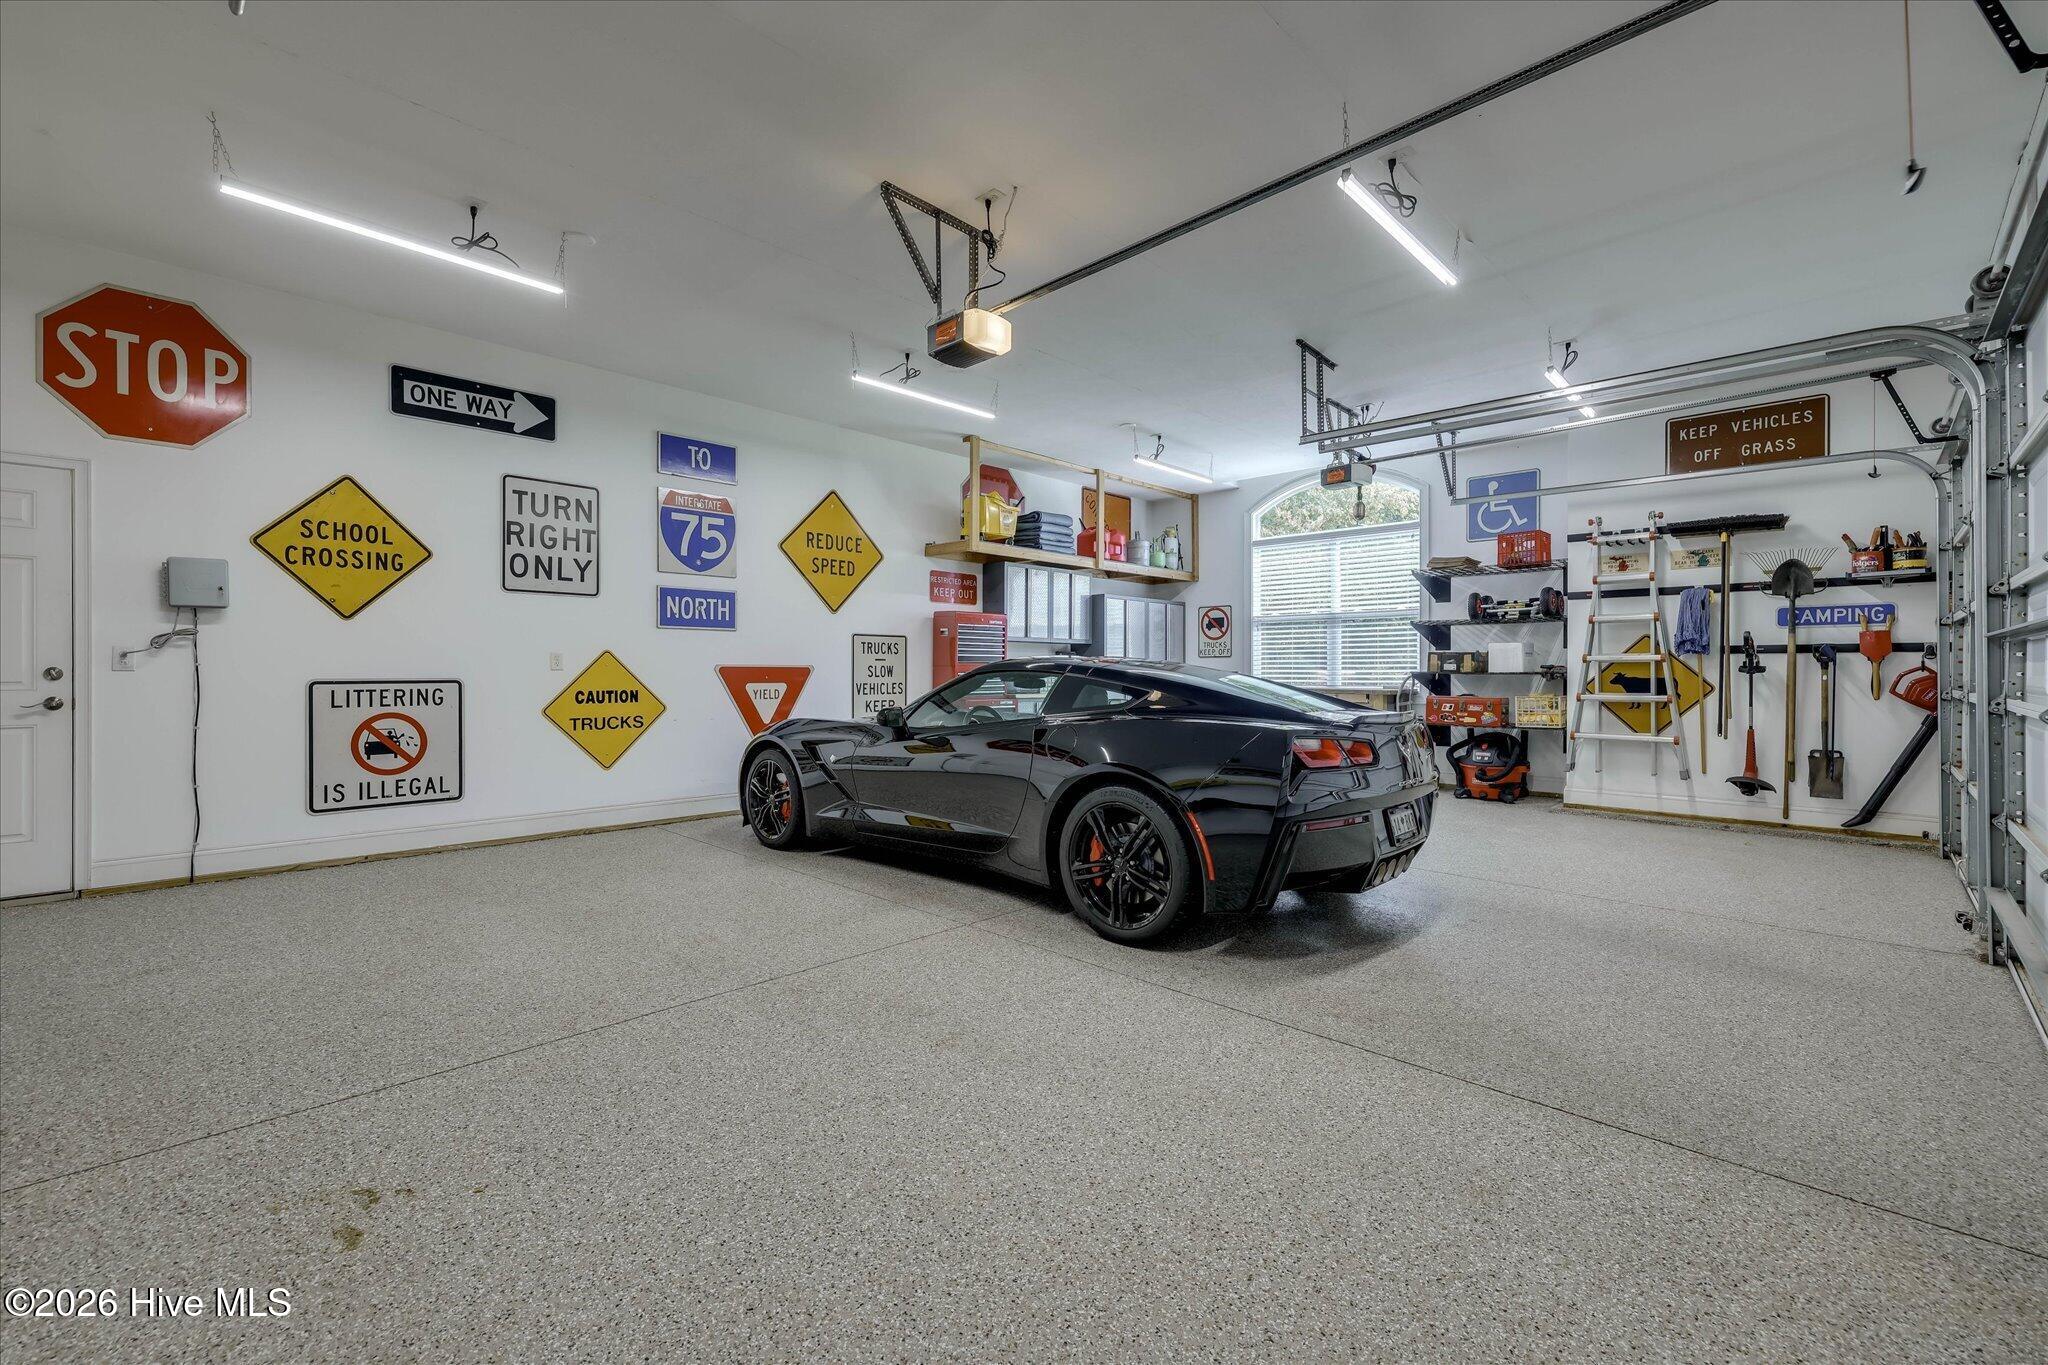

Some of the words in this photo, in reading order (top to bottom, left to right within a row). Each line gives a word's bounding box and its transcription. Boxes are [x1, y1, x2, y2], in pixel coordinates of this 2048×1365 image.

[55, 322, 239, 409] STOP
[410, 384, 457, 409] ONE
[466, 394, 513, 419] WAY
[1679, 424, 1718, 441] KEEP
[1731, 410, 1813, 433] VEHICLES
[687, 445, 712, 471] TO
[1694, 448, 1722, 463] OFF
[1741, 437, 1797, 457] GRASS
[512, 489, 592, 523] TURN
[675, 495, 722, 512] INTERSTATE
[300, 518, 394, 546] SCHOOL
[506, 521, 597, 553] RIGHT
[671, 511, 728, 560] 75
[806, 532, 863, 554] REDUCE
[284, 545, 404, 572] CROSSING
[509, 553, 592, 583] ONLY
[812, 558, 855, 577] SPEED
[931, 576, 961, 585] RESTRICTED
[963, 579, 977, 587] AREA
[934, 587, 955, 598] KEEP
[958, 589, 974, 600] OUT
[667, 595, 729, 621] NORTH
[861, 642, 899, 655] TRUCKS
[1203, 641, 1228, 649] TRUCKS
[1218, 648, 1231, 656] OFF
[867, 665, 894, 678] SLOW
[330, 688, 445, 709] LITTERING
[574, 690, 639, 705] CAUTION
[753, 688, 780, 701] YIELD
[856, 682, 904, 695] VEHICLES
[569, 715, 644, 731] TRUCKS
[323, 783, 346, 803] IS
[358, 775, 451, 801] ILLEGAL
